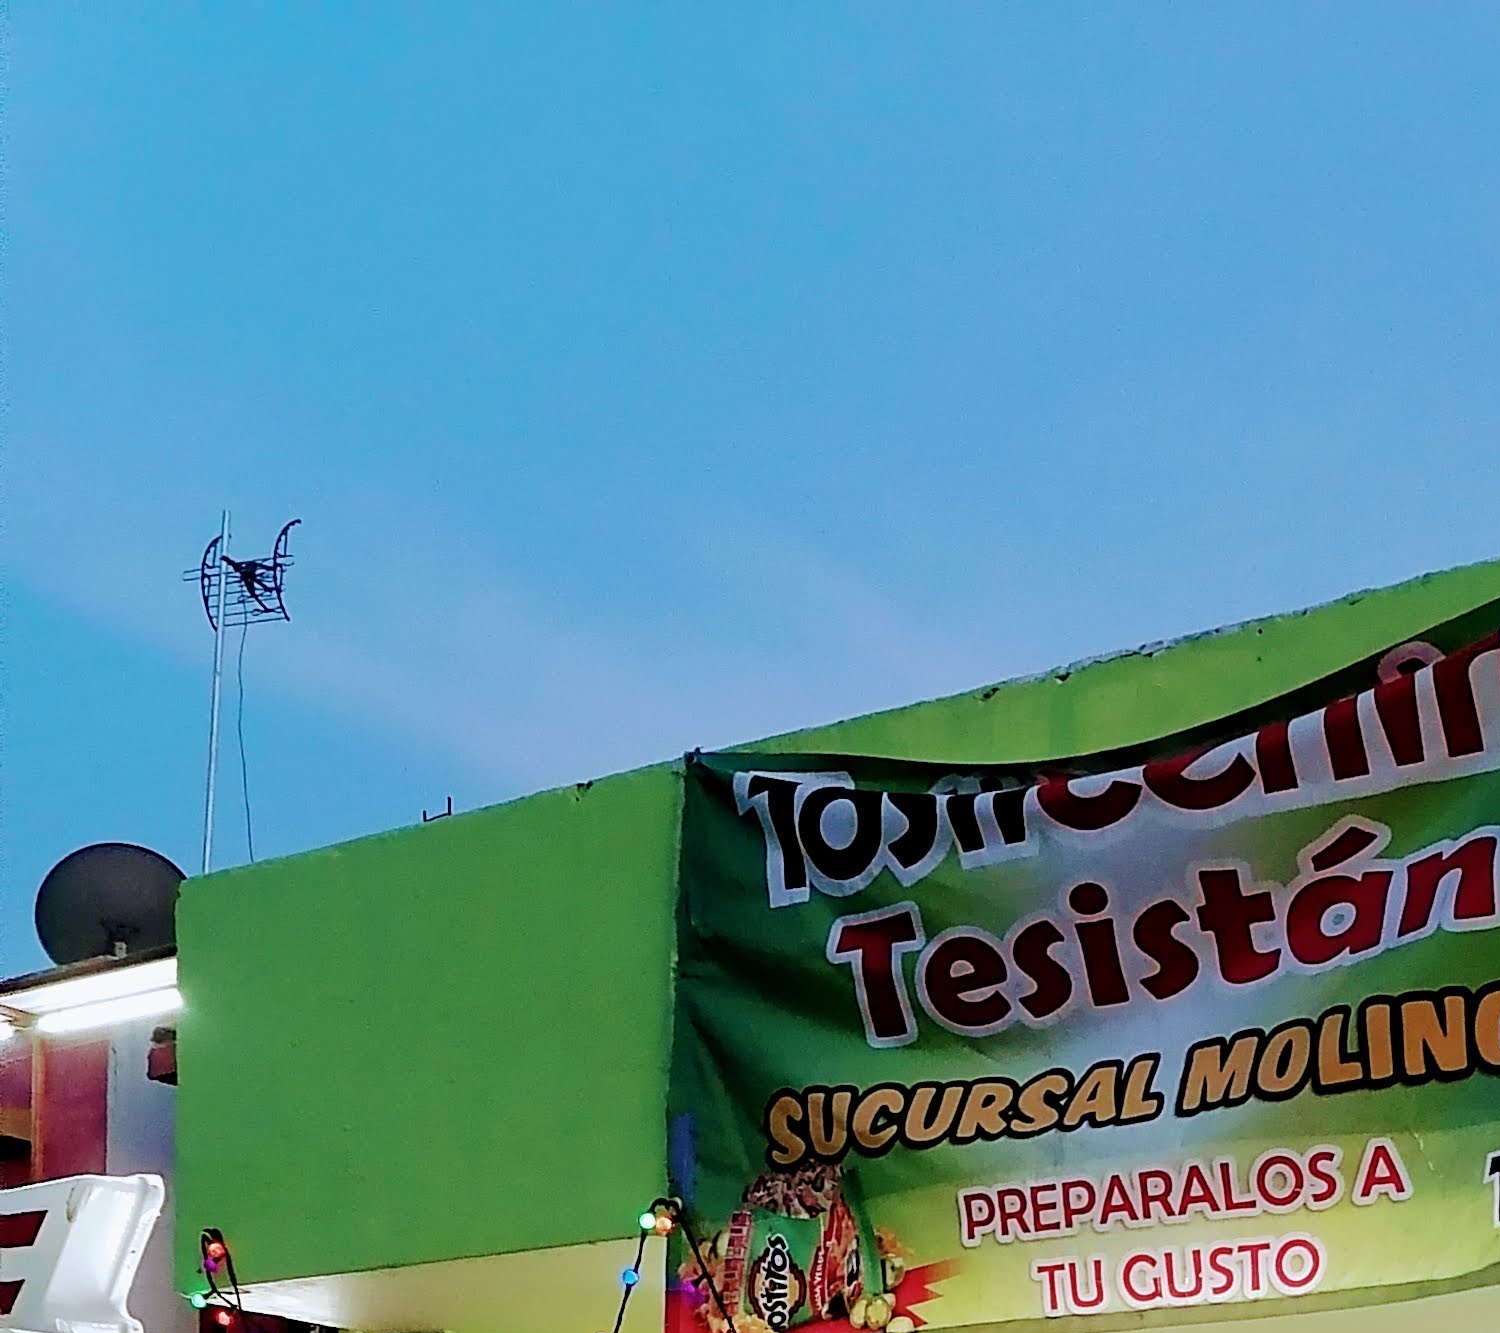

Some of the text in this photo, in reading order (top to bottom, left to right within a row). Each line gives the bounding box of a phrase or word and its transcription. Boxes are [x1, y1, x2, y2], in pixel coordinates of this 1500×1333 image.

[836, 825, 1498, 1038] Tesistán
[765, 1059, 1162, 1163] SUCURSAL
[966, 1145, 1407, 1239] PREPARALOS A
[1037, 1240, 1320, 1309] TU GUSTO
